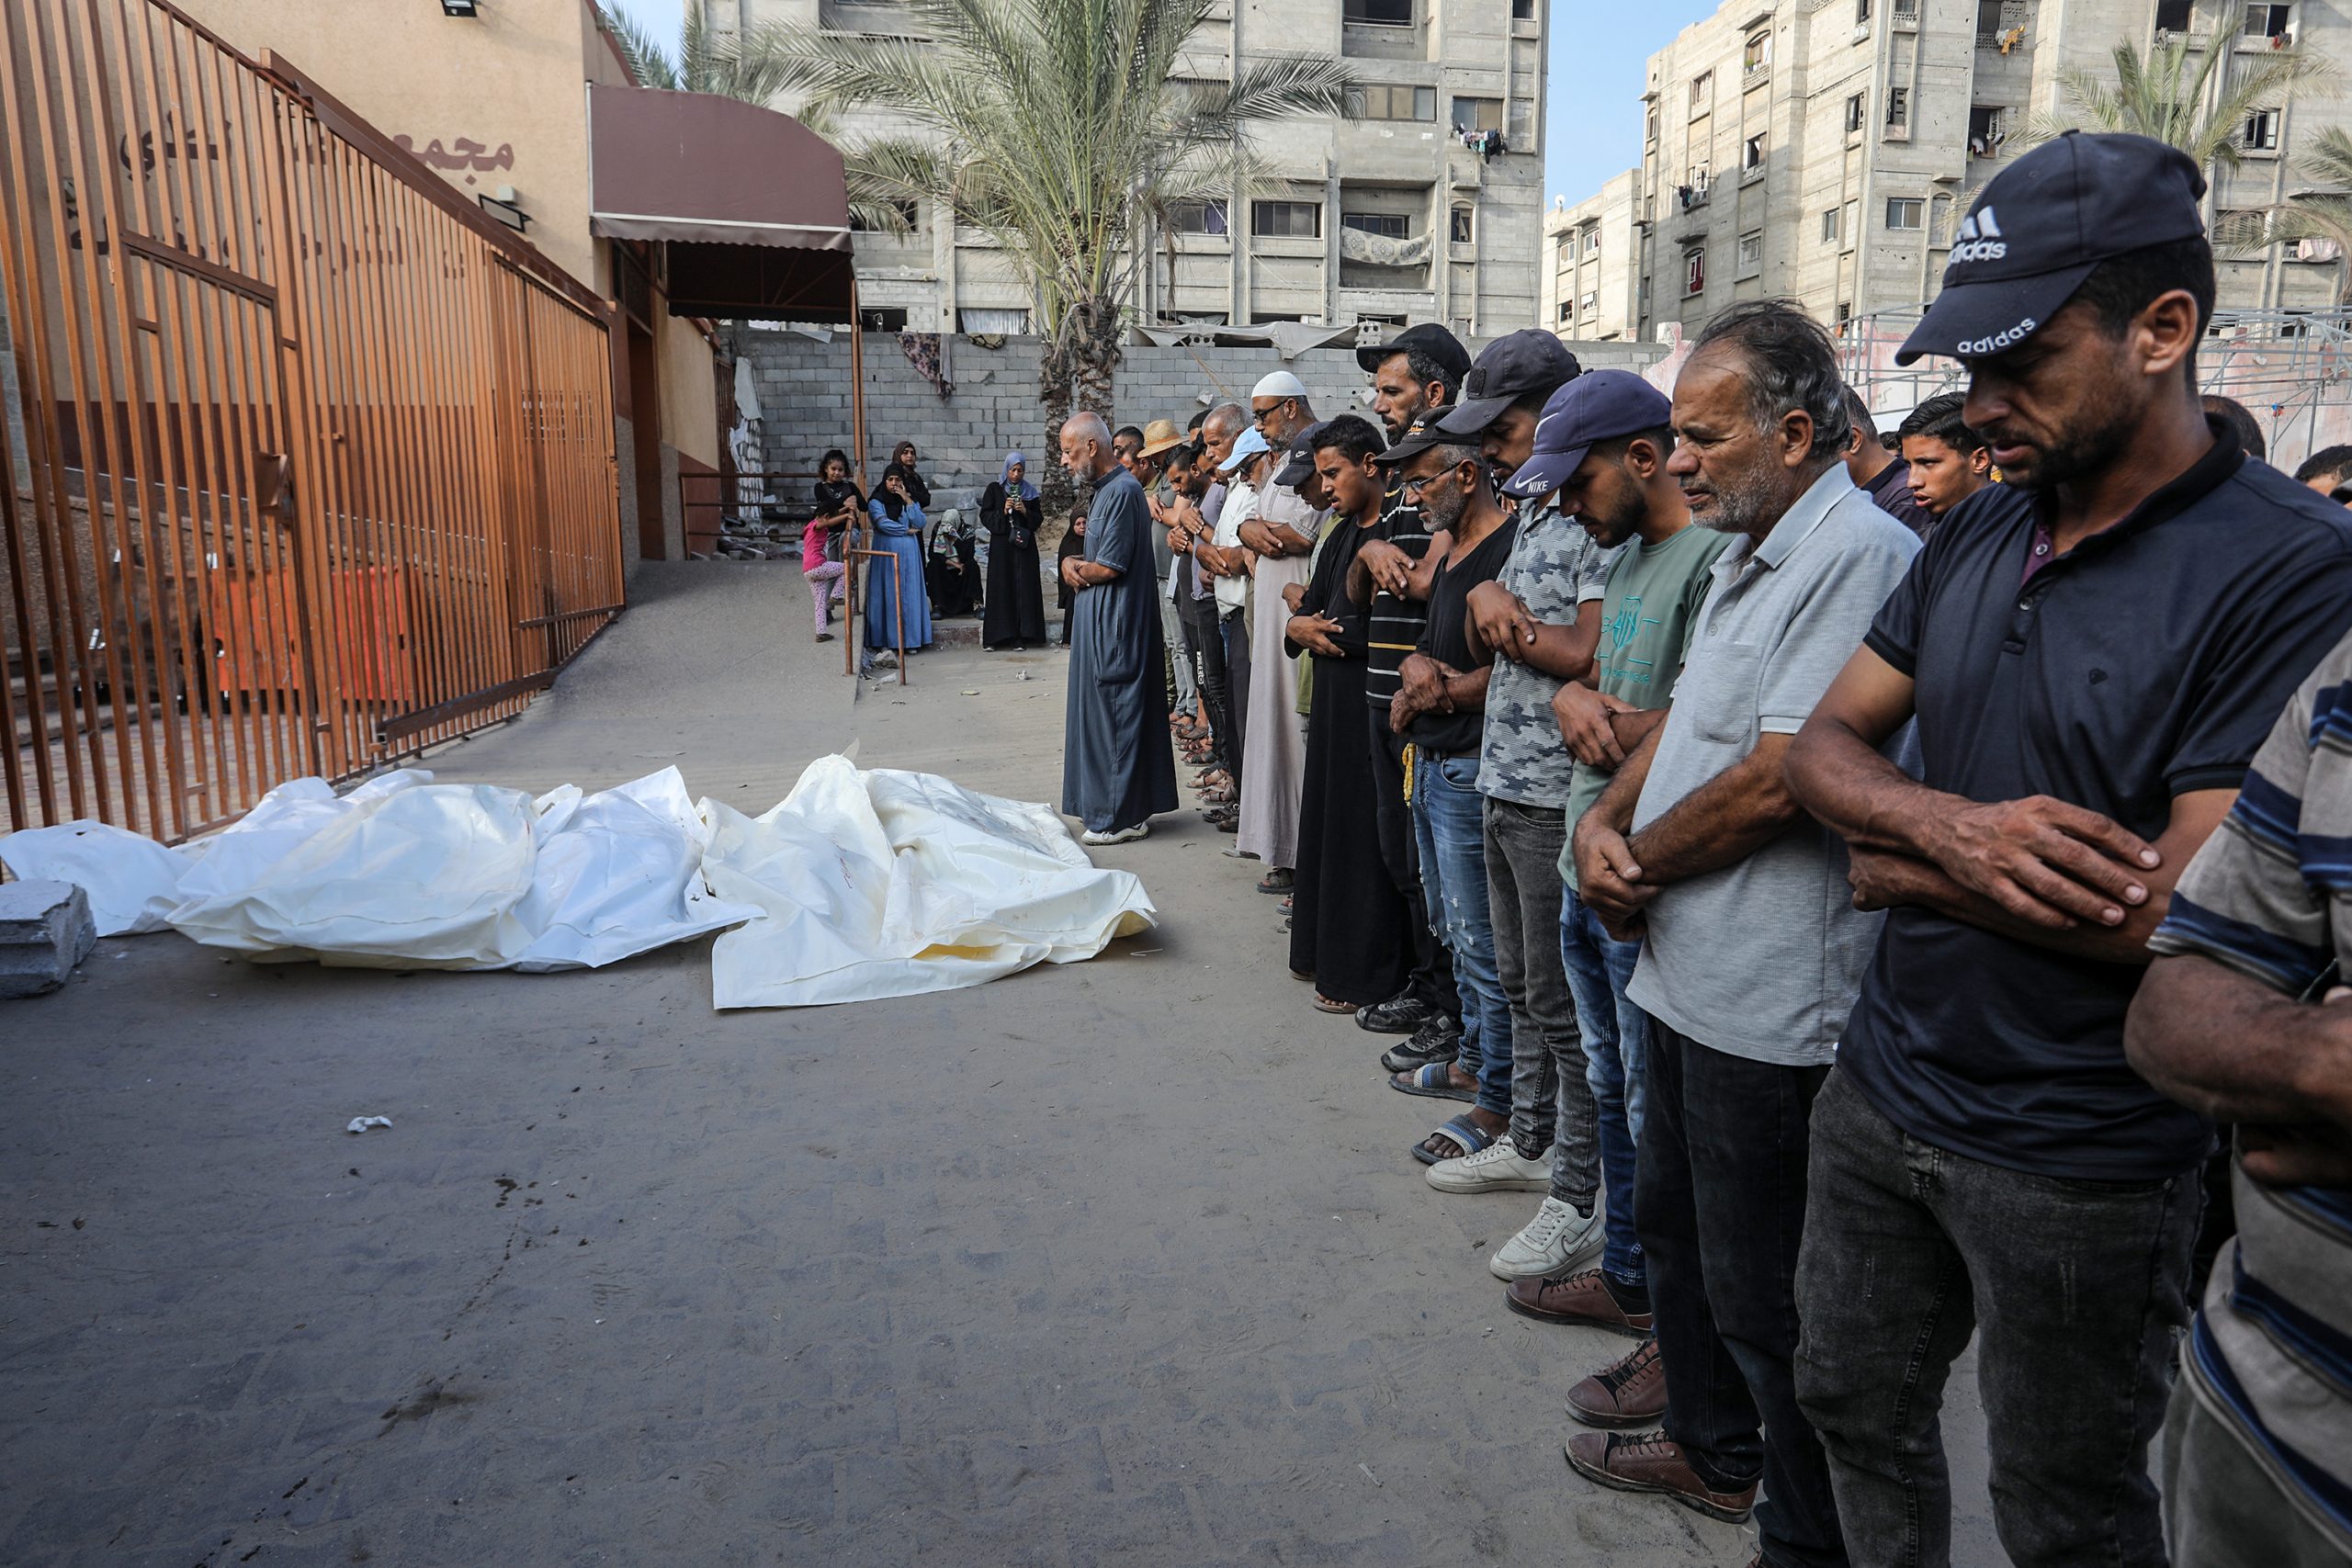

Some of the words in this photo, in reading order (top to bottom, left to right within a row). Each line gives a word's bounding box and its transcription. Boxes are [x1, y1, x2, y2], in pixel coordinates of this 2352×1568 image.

[1947, 241, 2007, 265] didas
[1957, 317, 2037, 355] adidas
[1527, 480, 1549, 493] NIKE
